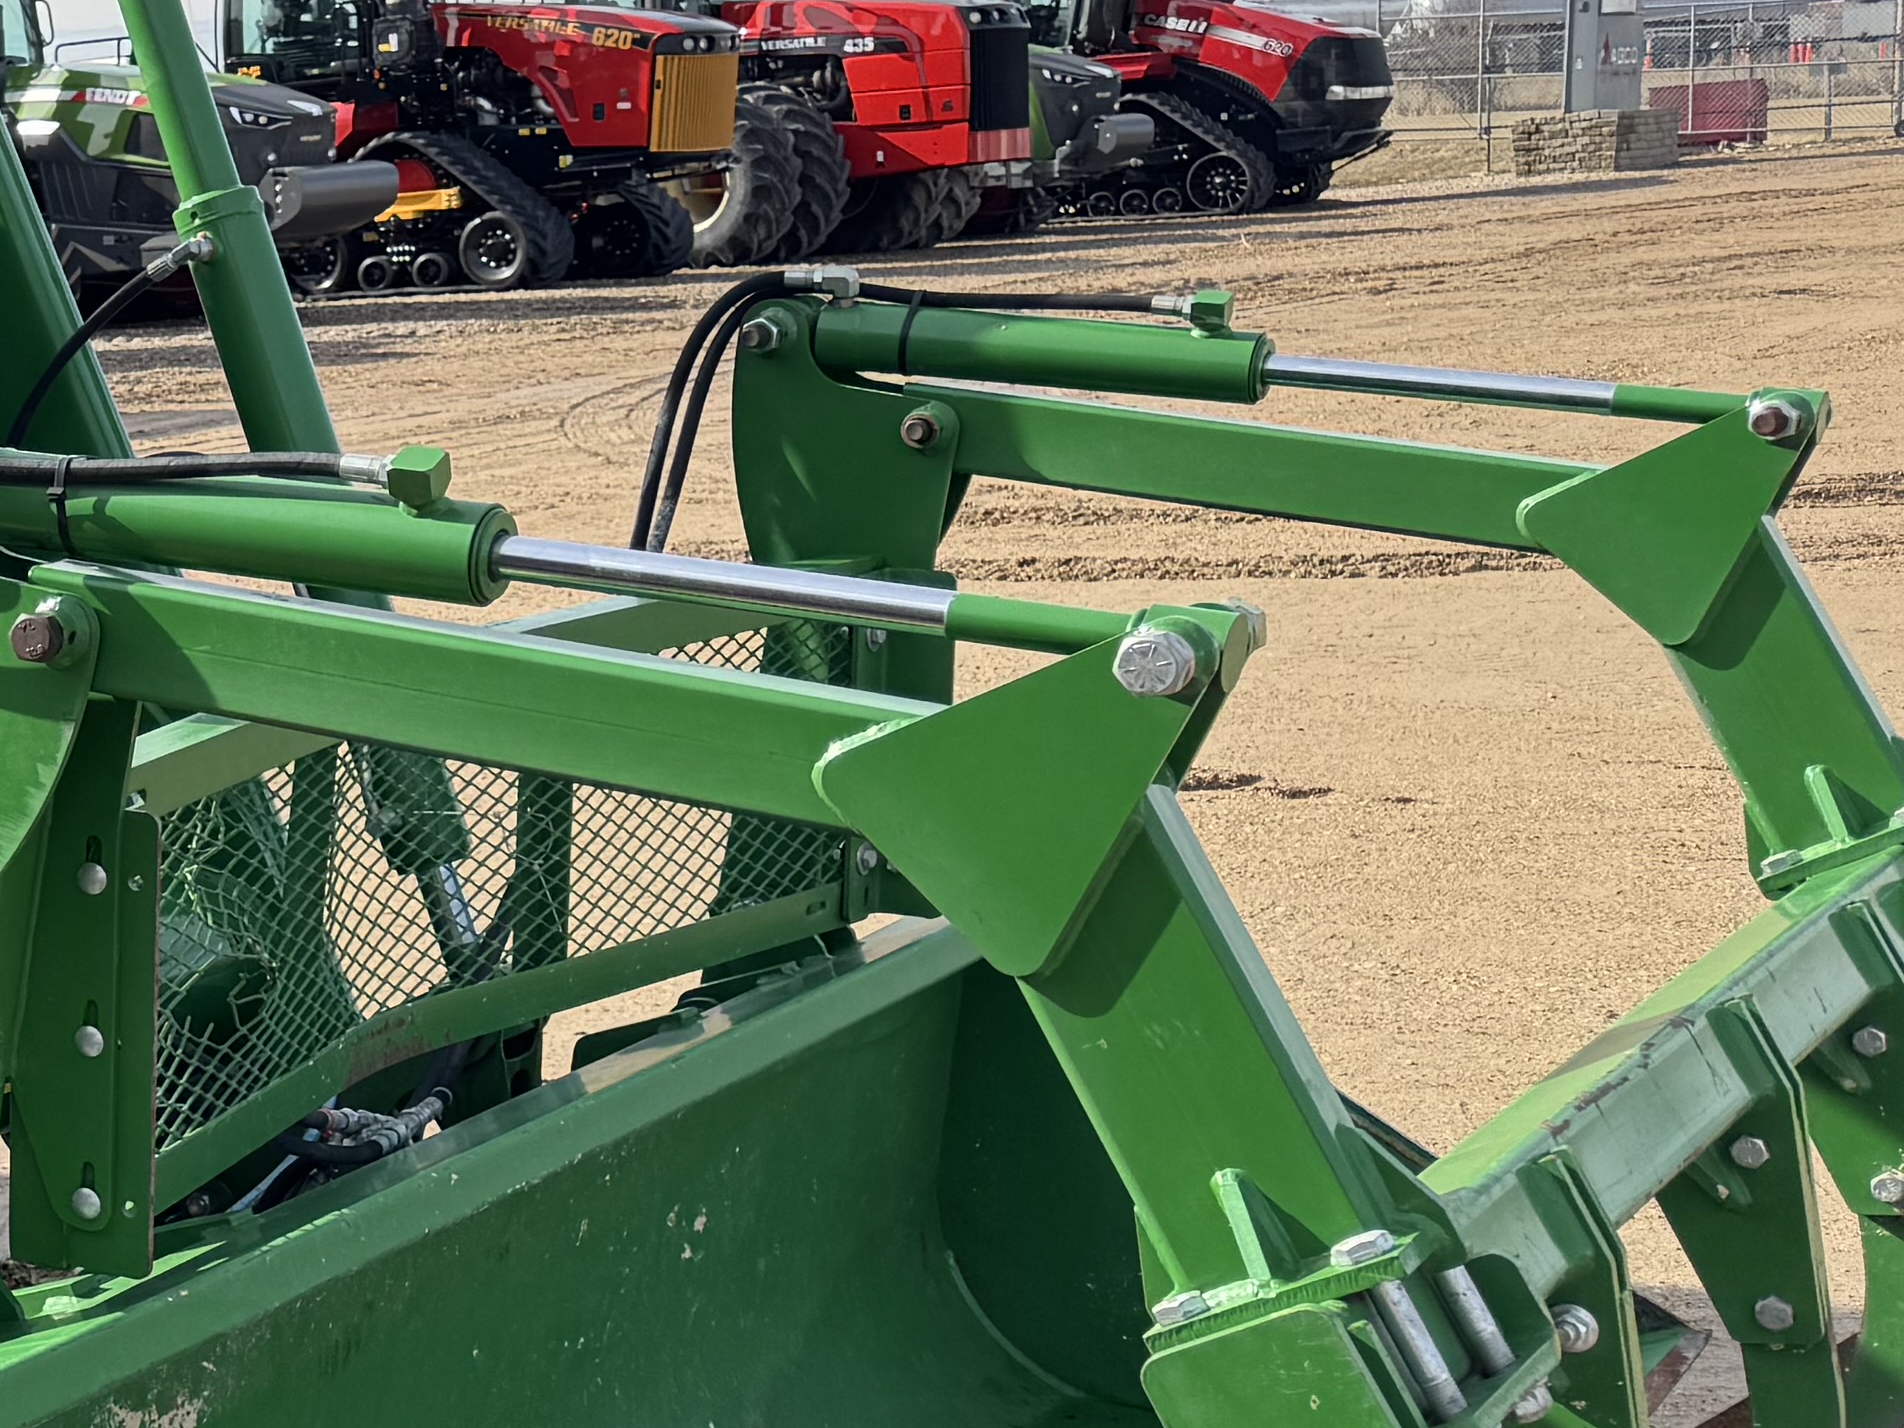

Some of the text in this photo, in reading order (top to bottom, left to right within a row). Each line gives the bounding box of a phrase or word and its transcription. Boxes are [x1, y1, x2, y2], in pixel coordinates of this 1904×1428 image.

[486, 15, 582, 36] VERSATILE
[760, 37, 827, 51] VERSATILE
[1263, 39, 1294, 56] 620
[85, 87, 142, 105] FENDT
